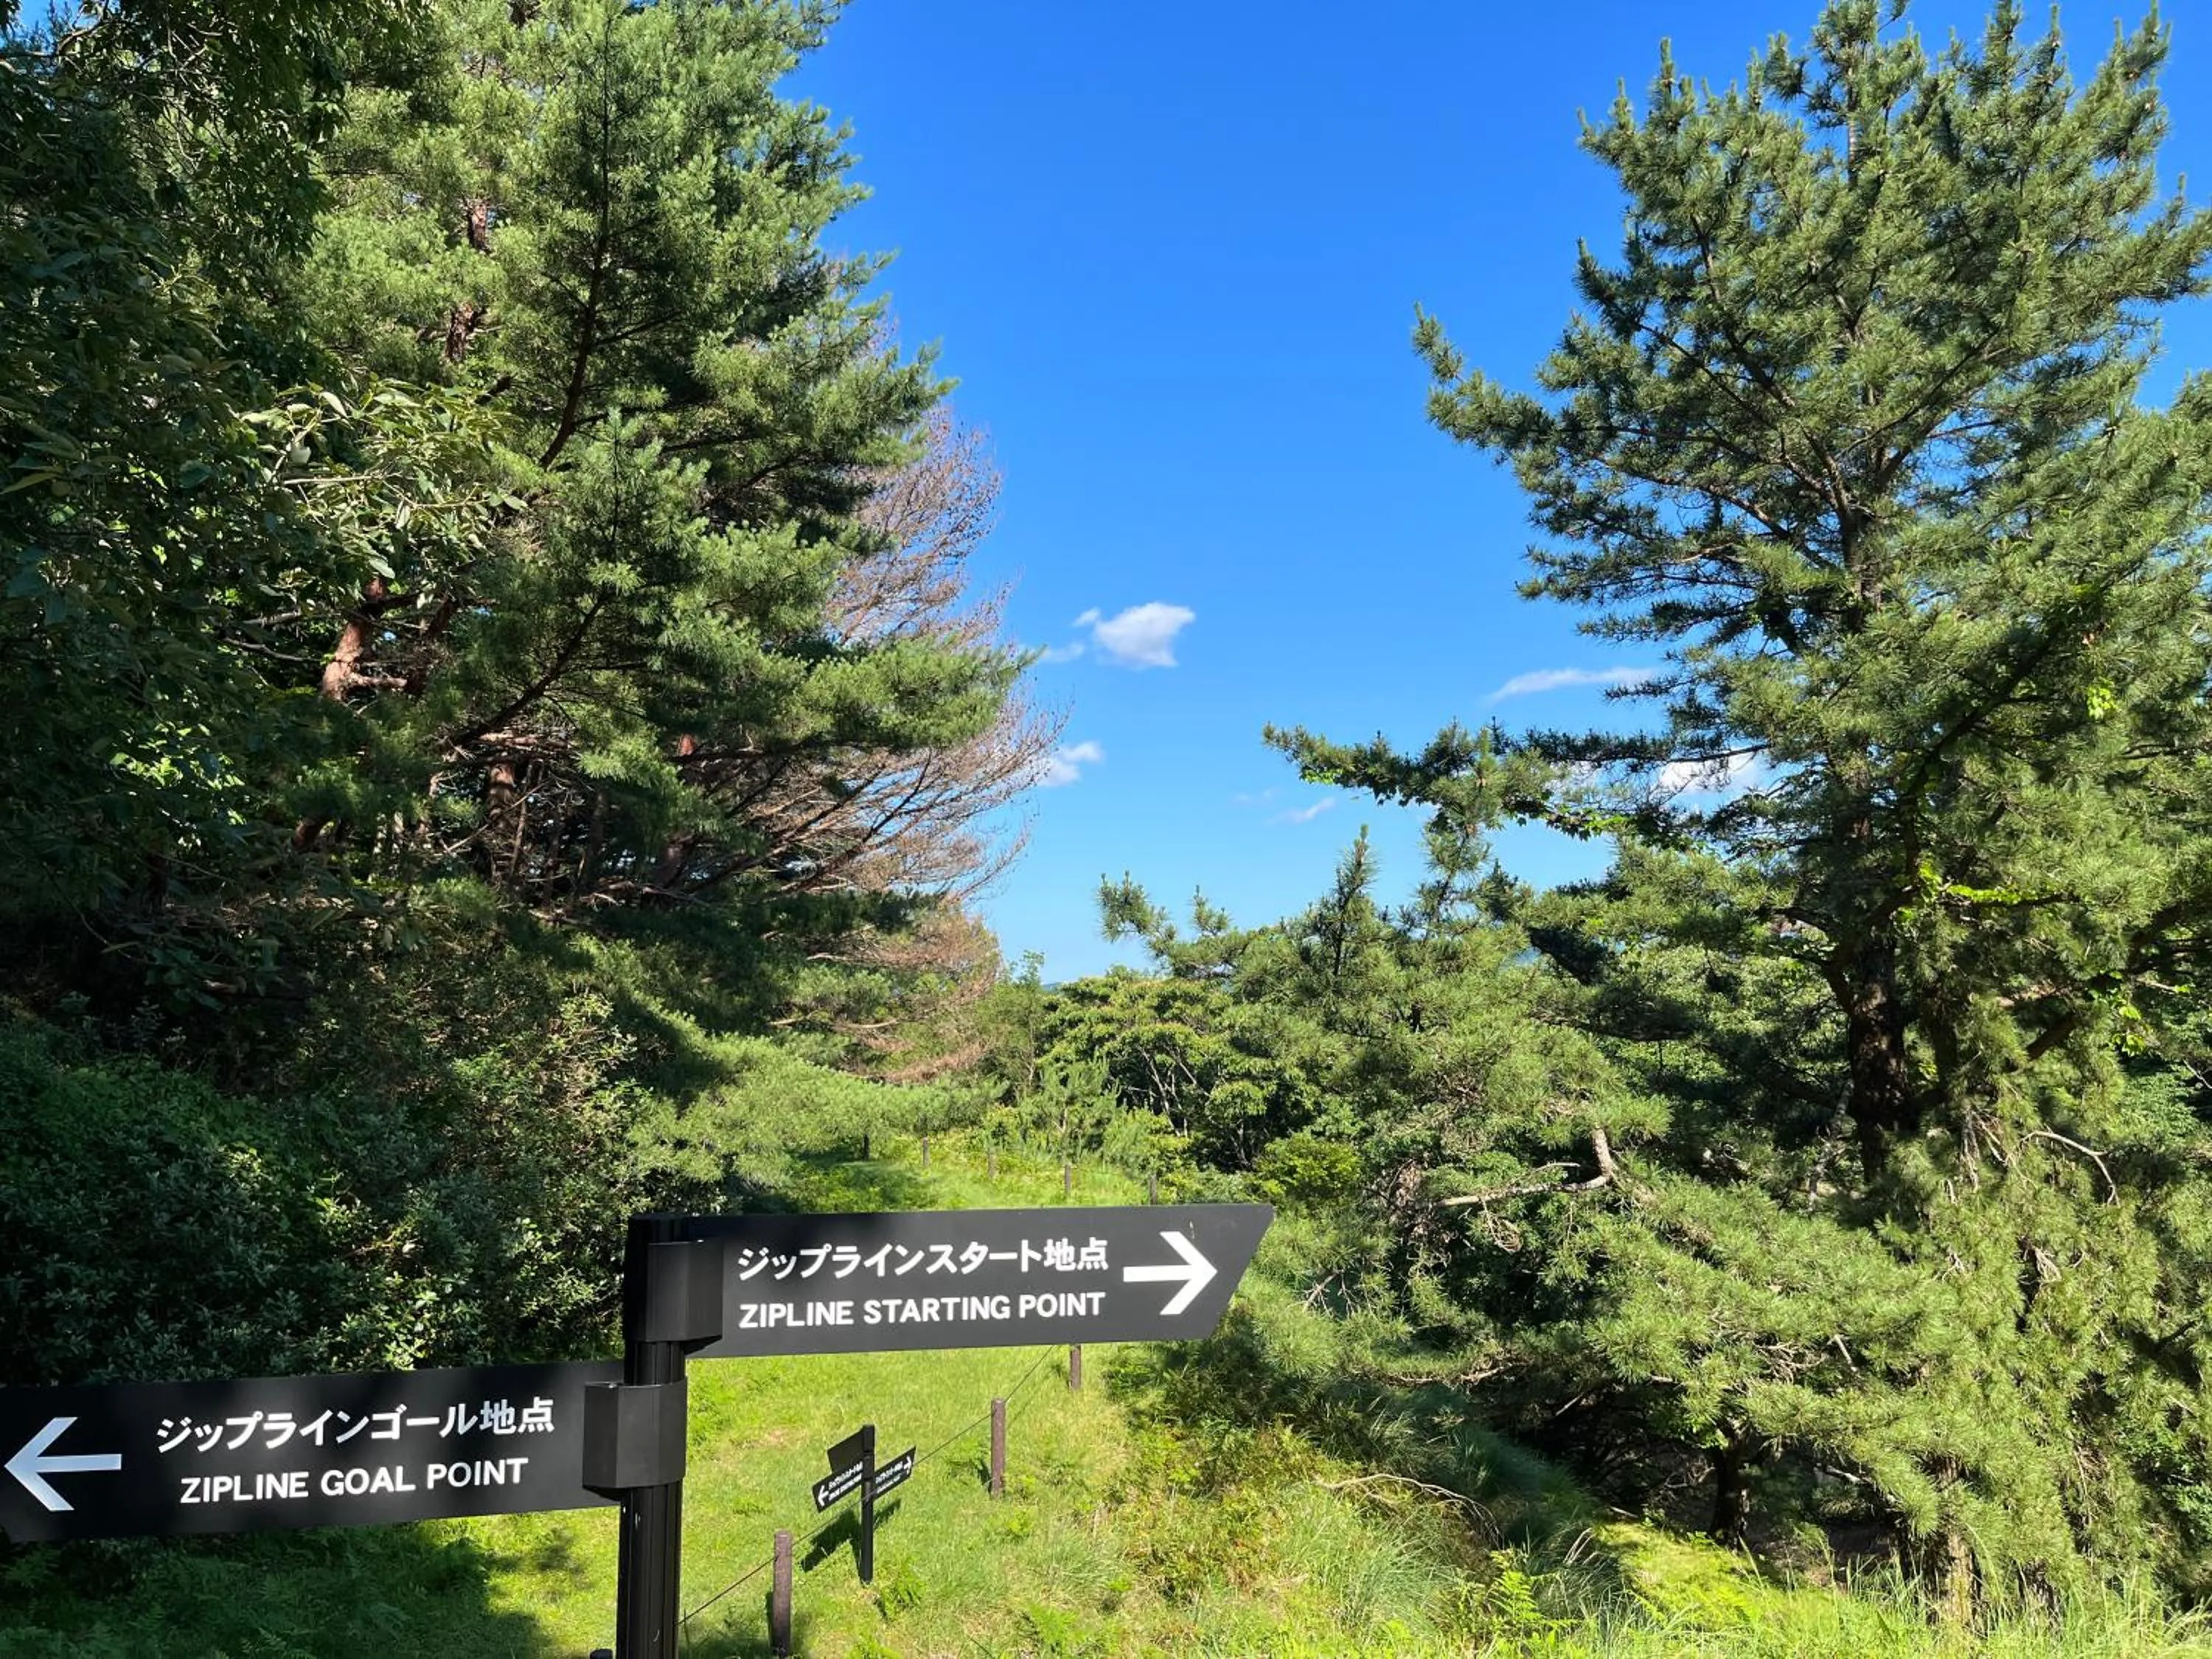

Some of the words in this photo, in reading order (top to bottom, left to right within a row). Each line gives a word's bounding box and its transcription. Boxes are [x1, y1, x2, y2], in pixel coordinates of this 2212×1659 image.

[737, 1237, 1110, 1281] ジップラインスタート地点
[737, 1301, 855, 1329] ZIPLINE
[863, 1293, 1011, 1326] STARTING
[1018, 1291, 1107, 1319] POINT
[156, 1396, 555, 1453] ジップラインゴール地点
[180, 1471, 310, 1503] ZIPLINE
[320, 1465, 417, 1496] GOAL
[426, 1457, 529, 1490] POINT
